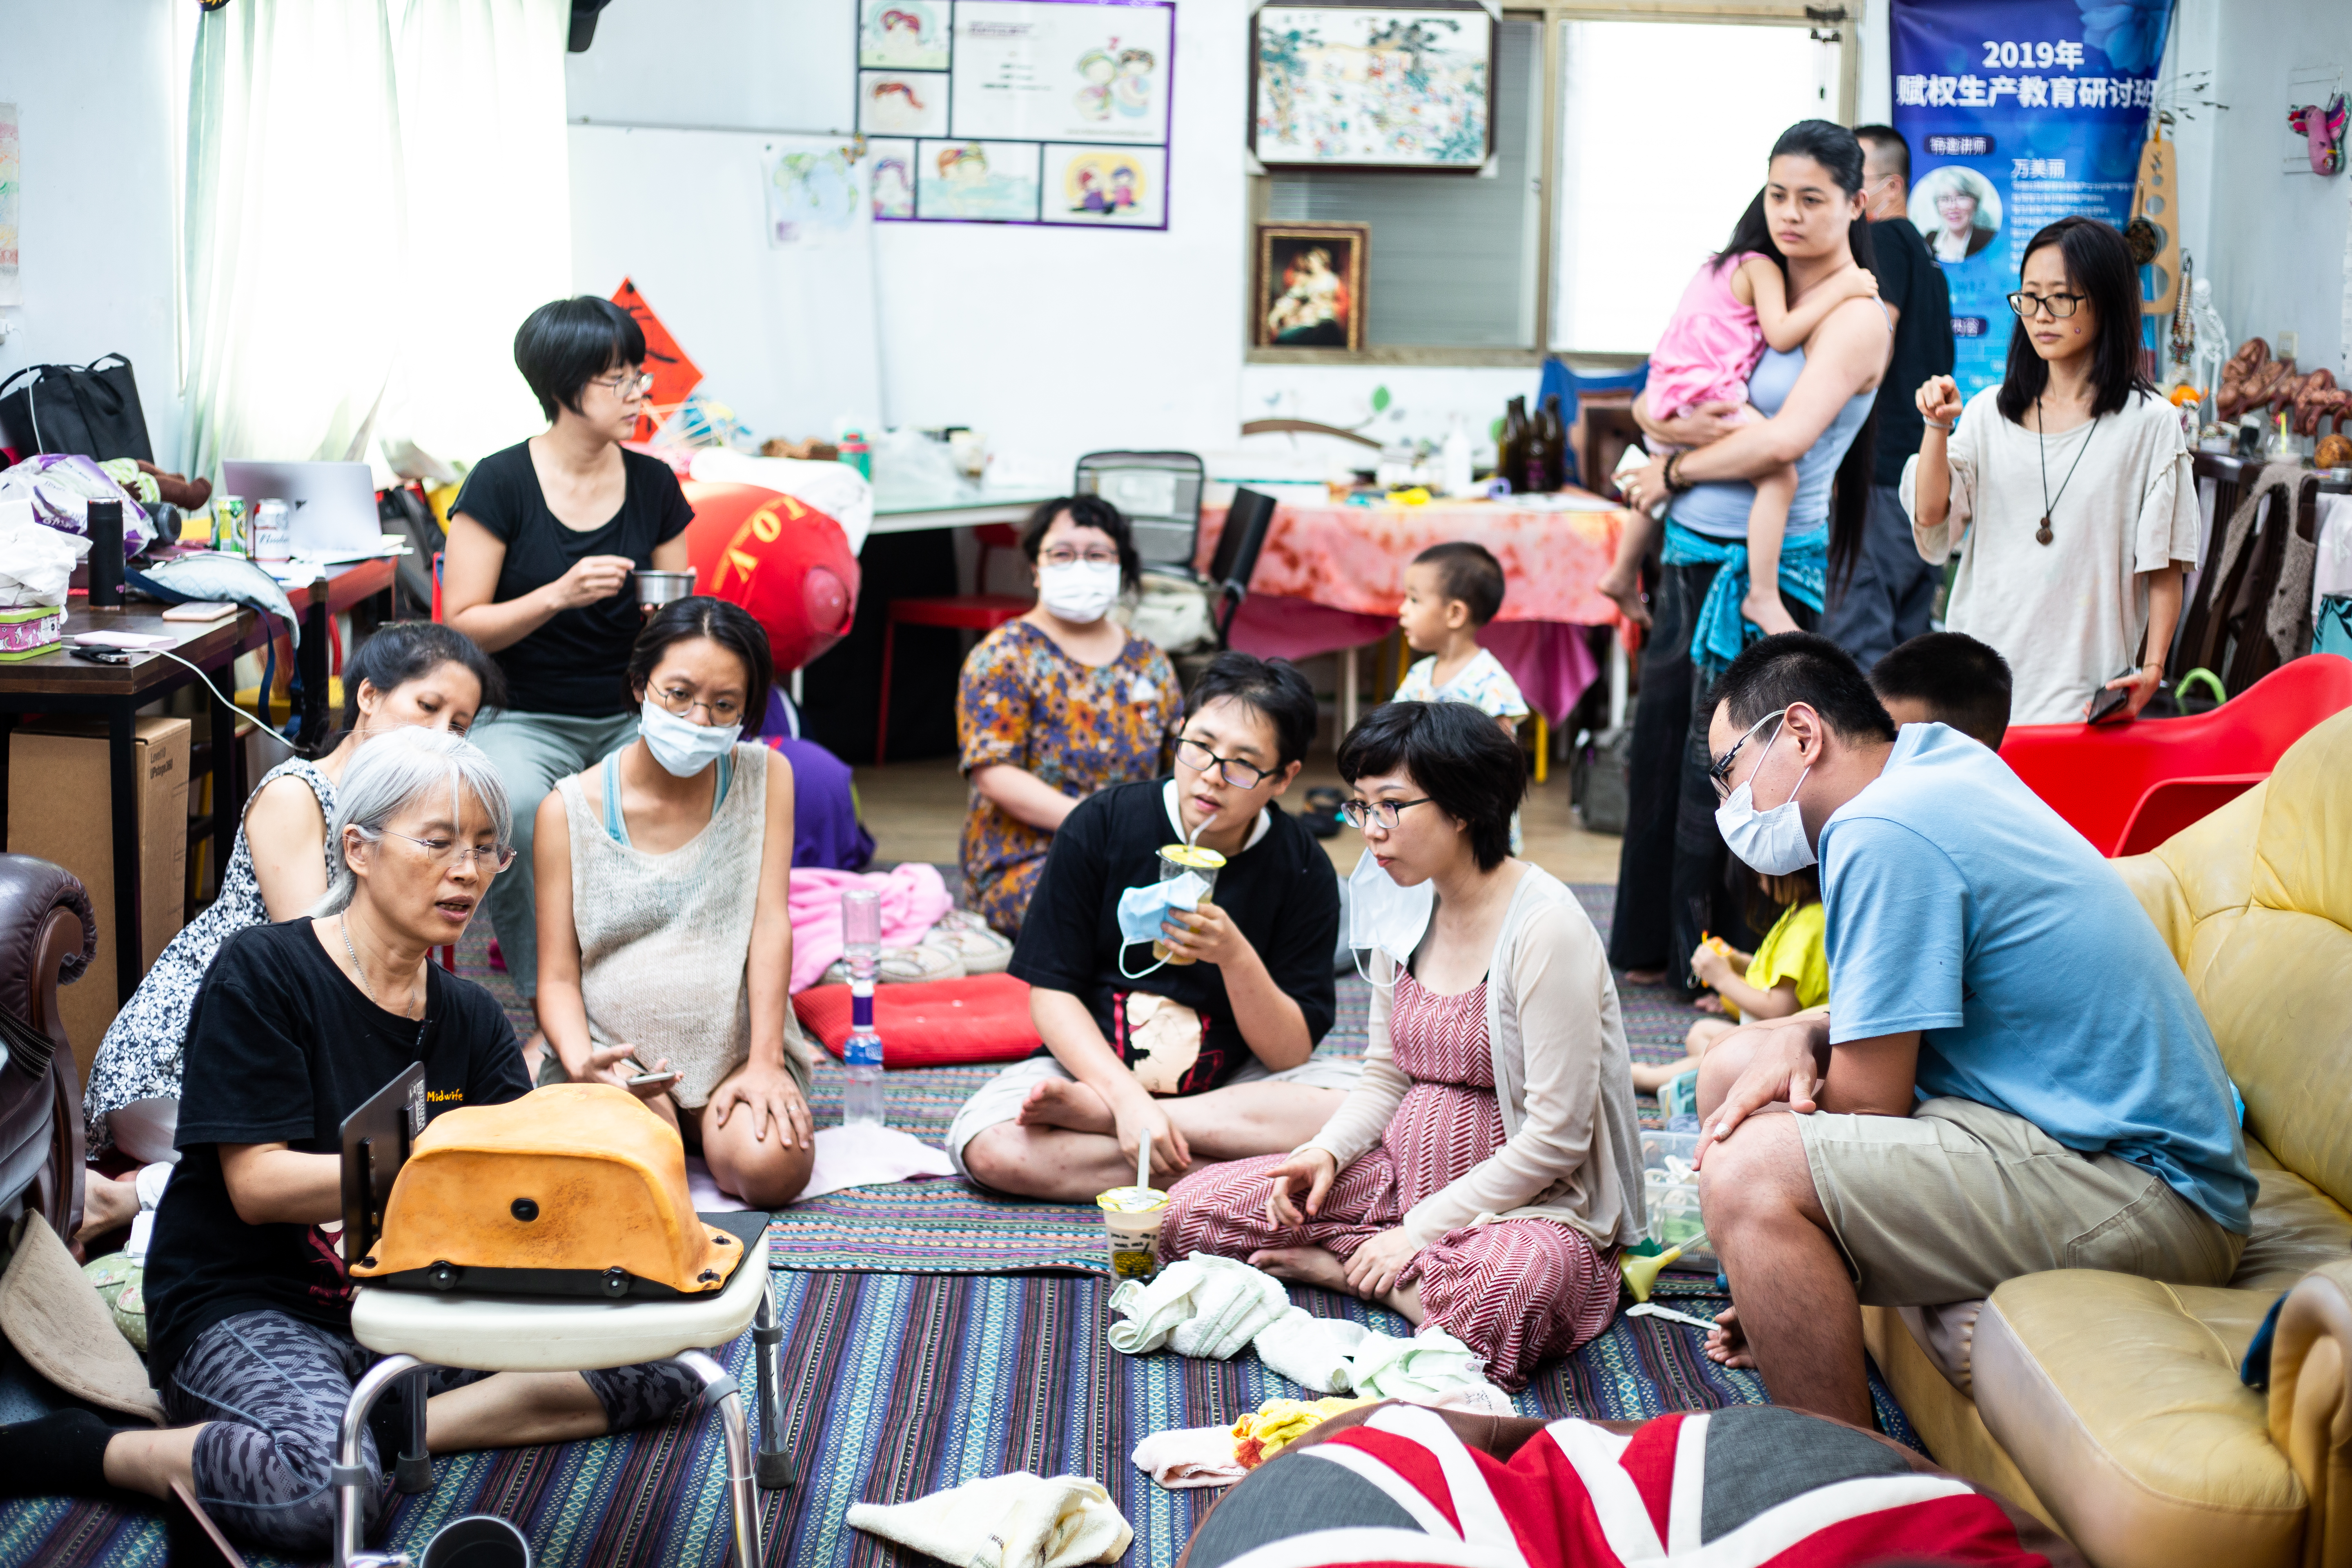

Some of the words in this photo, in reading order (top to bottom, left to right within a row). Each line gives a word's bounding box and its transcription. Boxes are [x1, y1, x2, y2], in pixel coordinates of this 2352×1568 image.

[1982, 40, 2085, 71] 2019年
[1896, 74, 2158, 108] 赋权生产教育研讨班
[2011, 158, 2066, 179] 万美丽
[427, 1088, 463, 1102] Midwife
